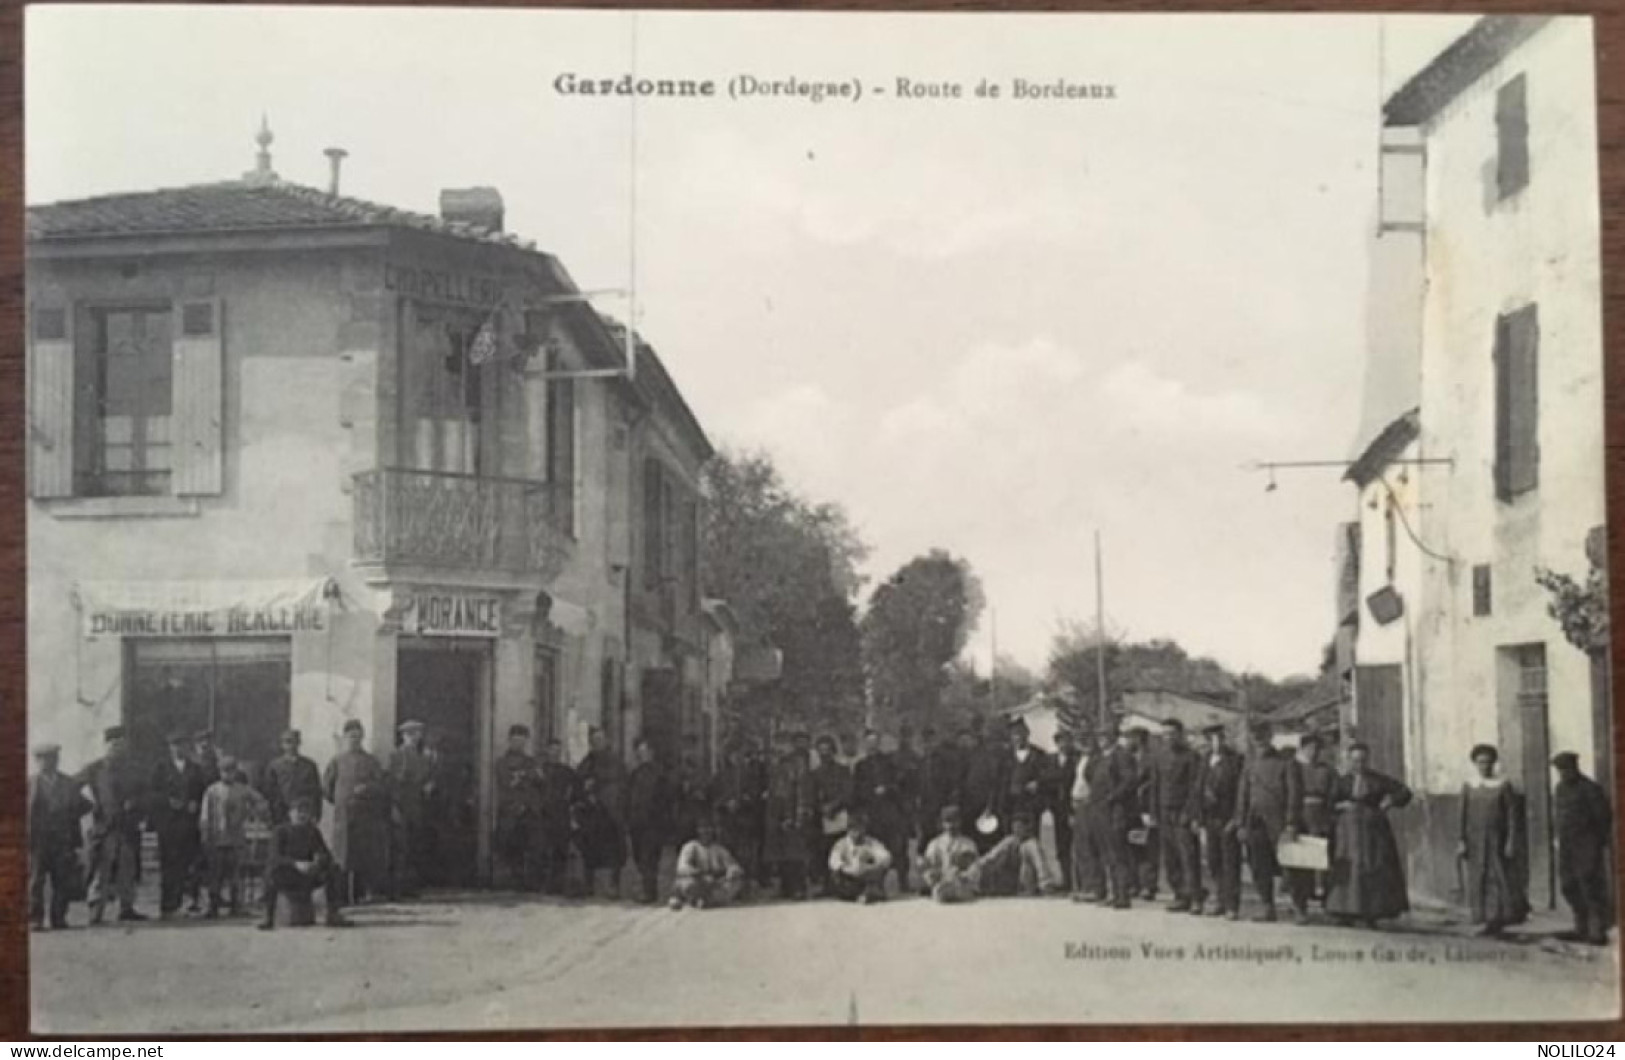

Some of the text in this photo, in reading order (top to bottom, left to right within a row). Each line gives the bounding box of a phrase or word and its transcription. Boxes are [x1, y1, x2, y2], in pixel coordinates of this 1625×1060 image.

[553, 73, 716, 97] Gardonne
[728, 74, 862, 102] (Dordogne)
[895, 77, 963, 98] Route
[975, 77, 1001, 98] de
[1012, 78, 1117, 99] Bordeaux
[1064, 943, 1131, 960] Edition
